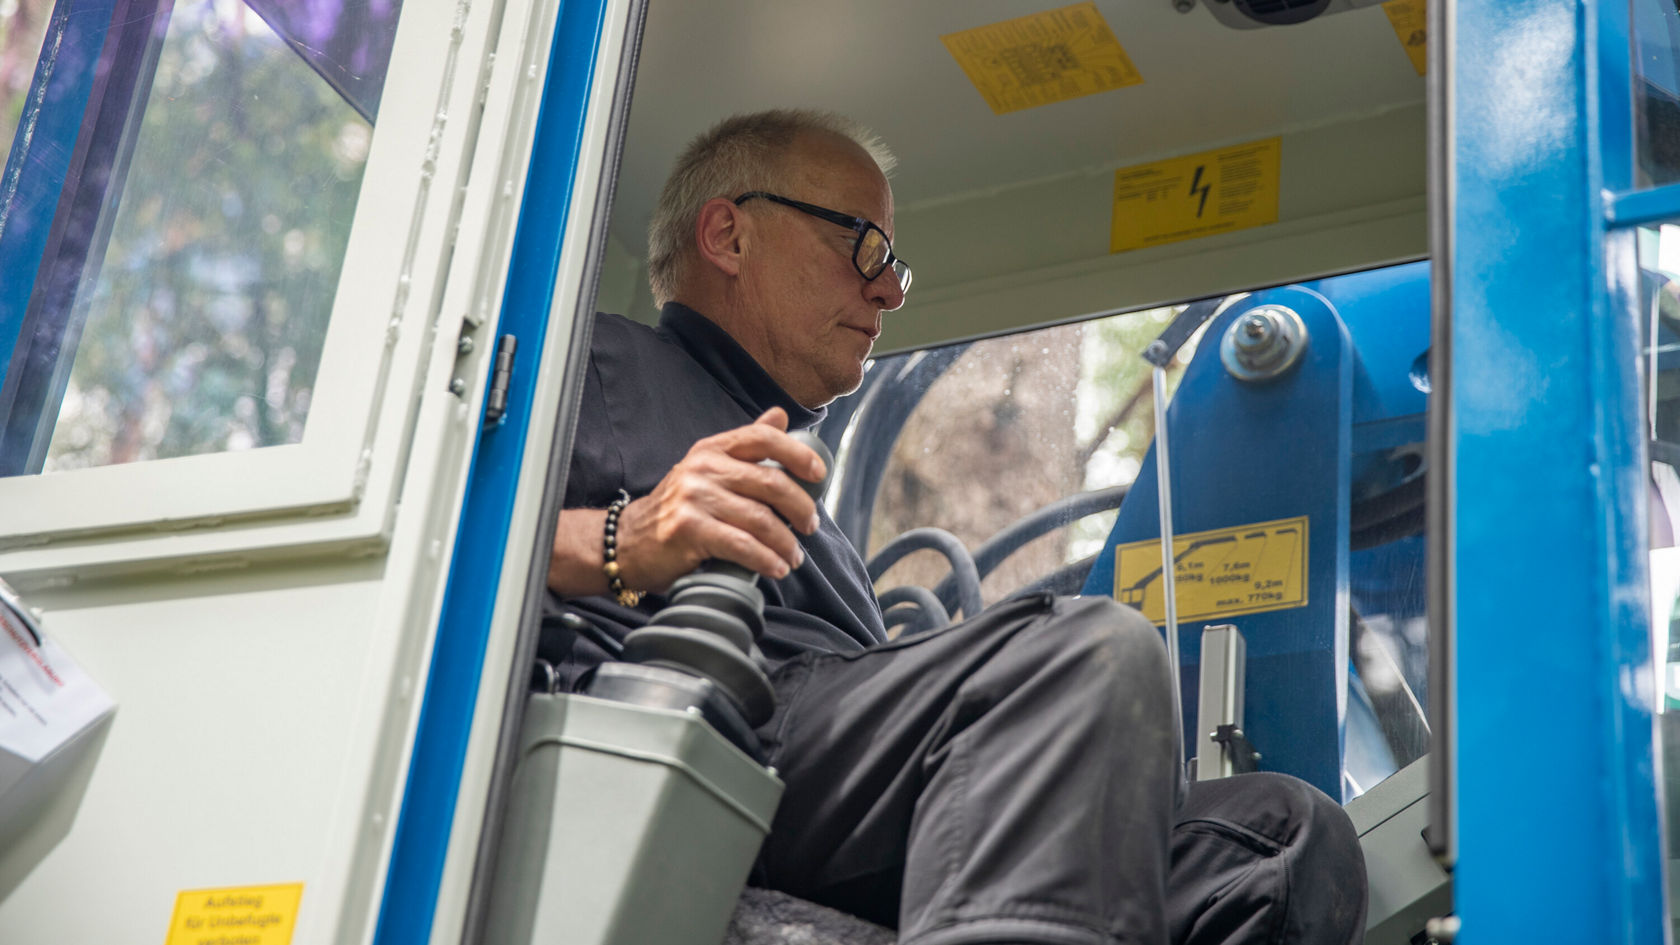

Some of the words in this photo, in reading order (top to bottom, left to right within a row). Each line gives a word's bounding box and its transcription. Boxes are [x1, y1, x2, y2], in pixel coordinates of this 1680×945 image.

[1223, 561, 1250, 571] 7,6m
[1210, 573, 1250, 584] 1000kg
[1254, 580, 1283, 589] 9,2m
[1216, 598, 1244, 606] max.
[1248, 592, 1283, 601] 770kg
[205, 895, 263, 908] Aufstieg
[186, 917, 203, 928] für
[209, 914, 280, 928] Unbefugte
